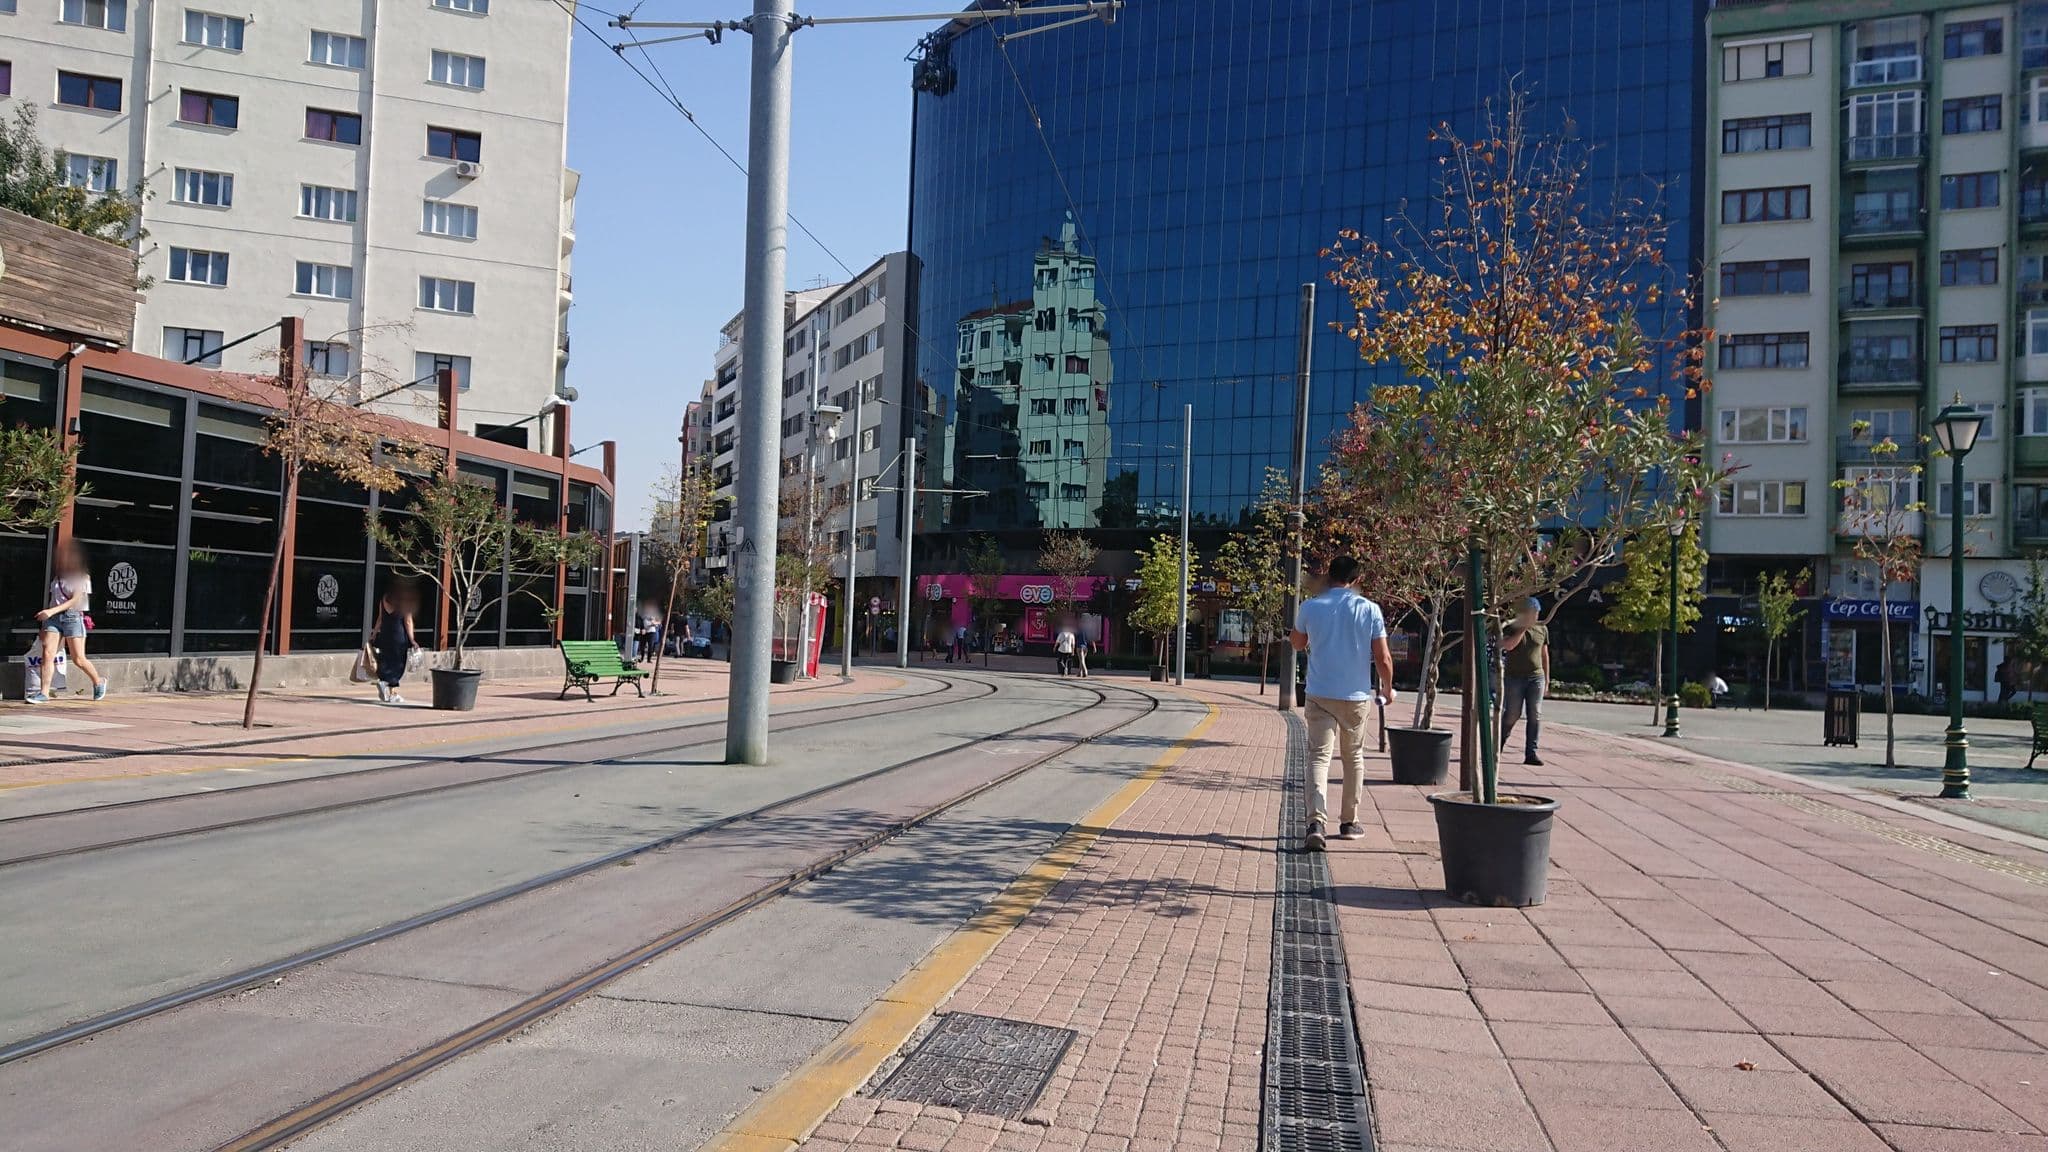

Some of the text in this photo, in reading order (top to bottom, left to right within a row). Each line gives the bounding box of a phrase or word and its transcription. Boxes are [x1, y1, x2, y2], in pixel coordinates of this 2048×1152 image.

[1021, 586, 1053, 603] eve
[106, 600, 137, 610] DUBLIN
[1829, 602, 1858, 617] Cep
